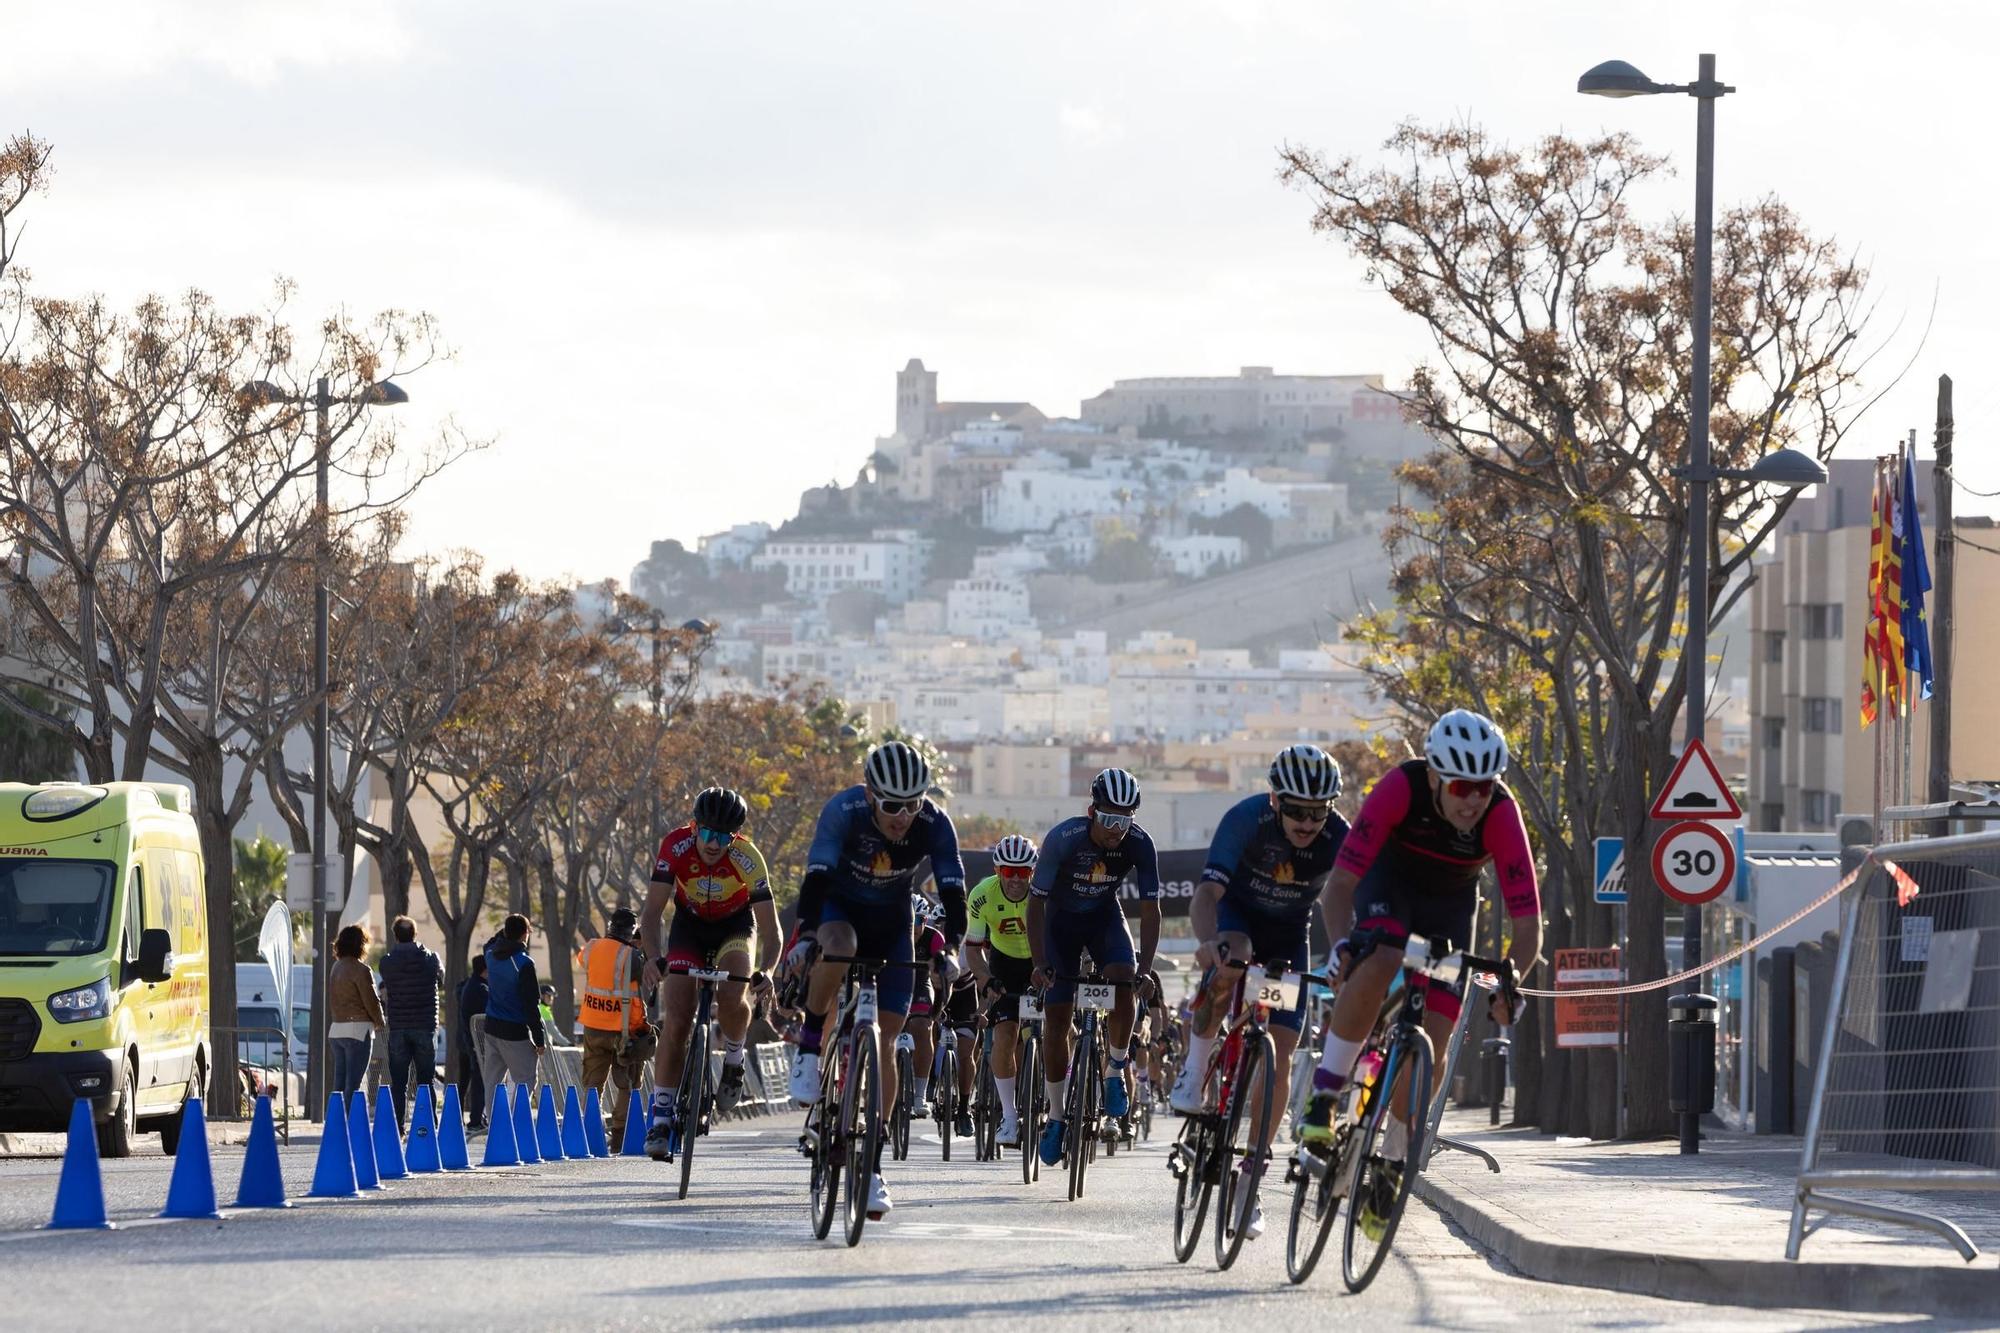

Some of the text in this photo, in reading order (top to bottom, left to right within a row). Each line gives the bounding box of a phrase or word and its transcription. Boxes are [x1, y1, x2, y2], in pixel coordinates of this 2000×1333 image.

[1672, 849, 1716, 876] 30
[1557, 952, 1618, 969] ATENCI
[1083, 987, 1109, 997] 206
[1259, 986, 1281, 1002] 36
